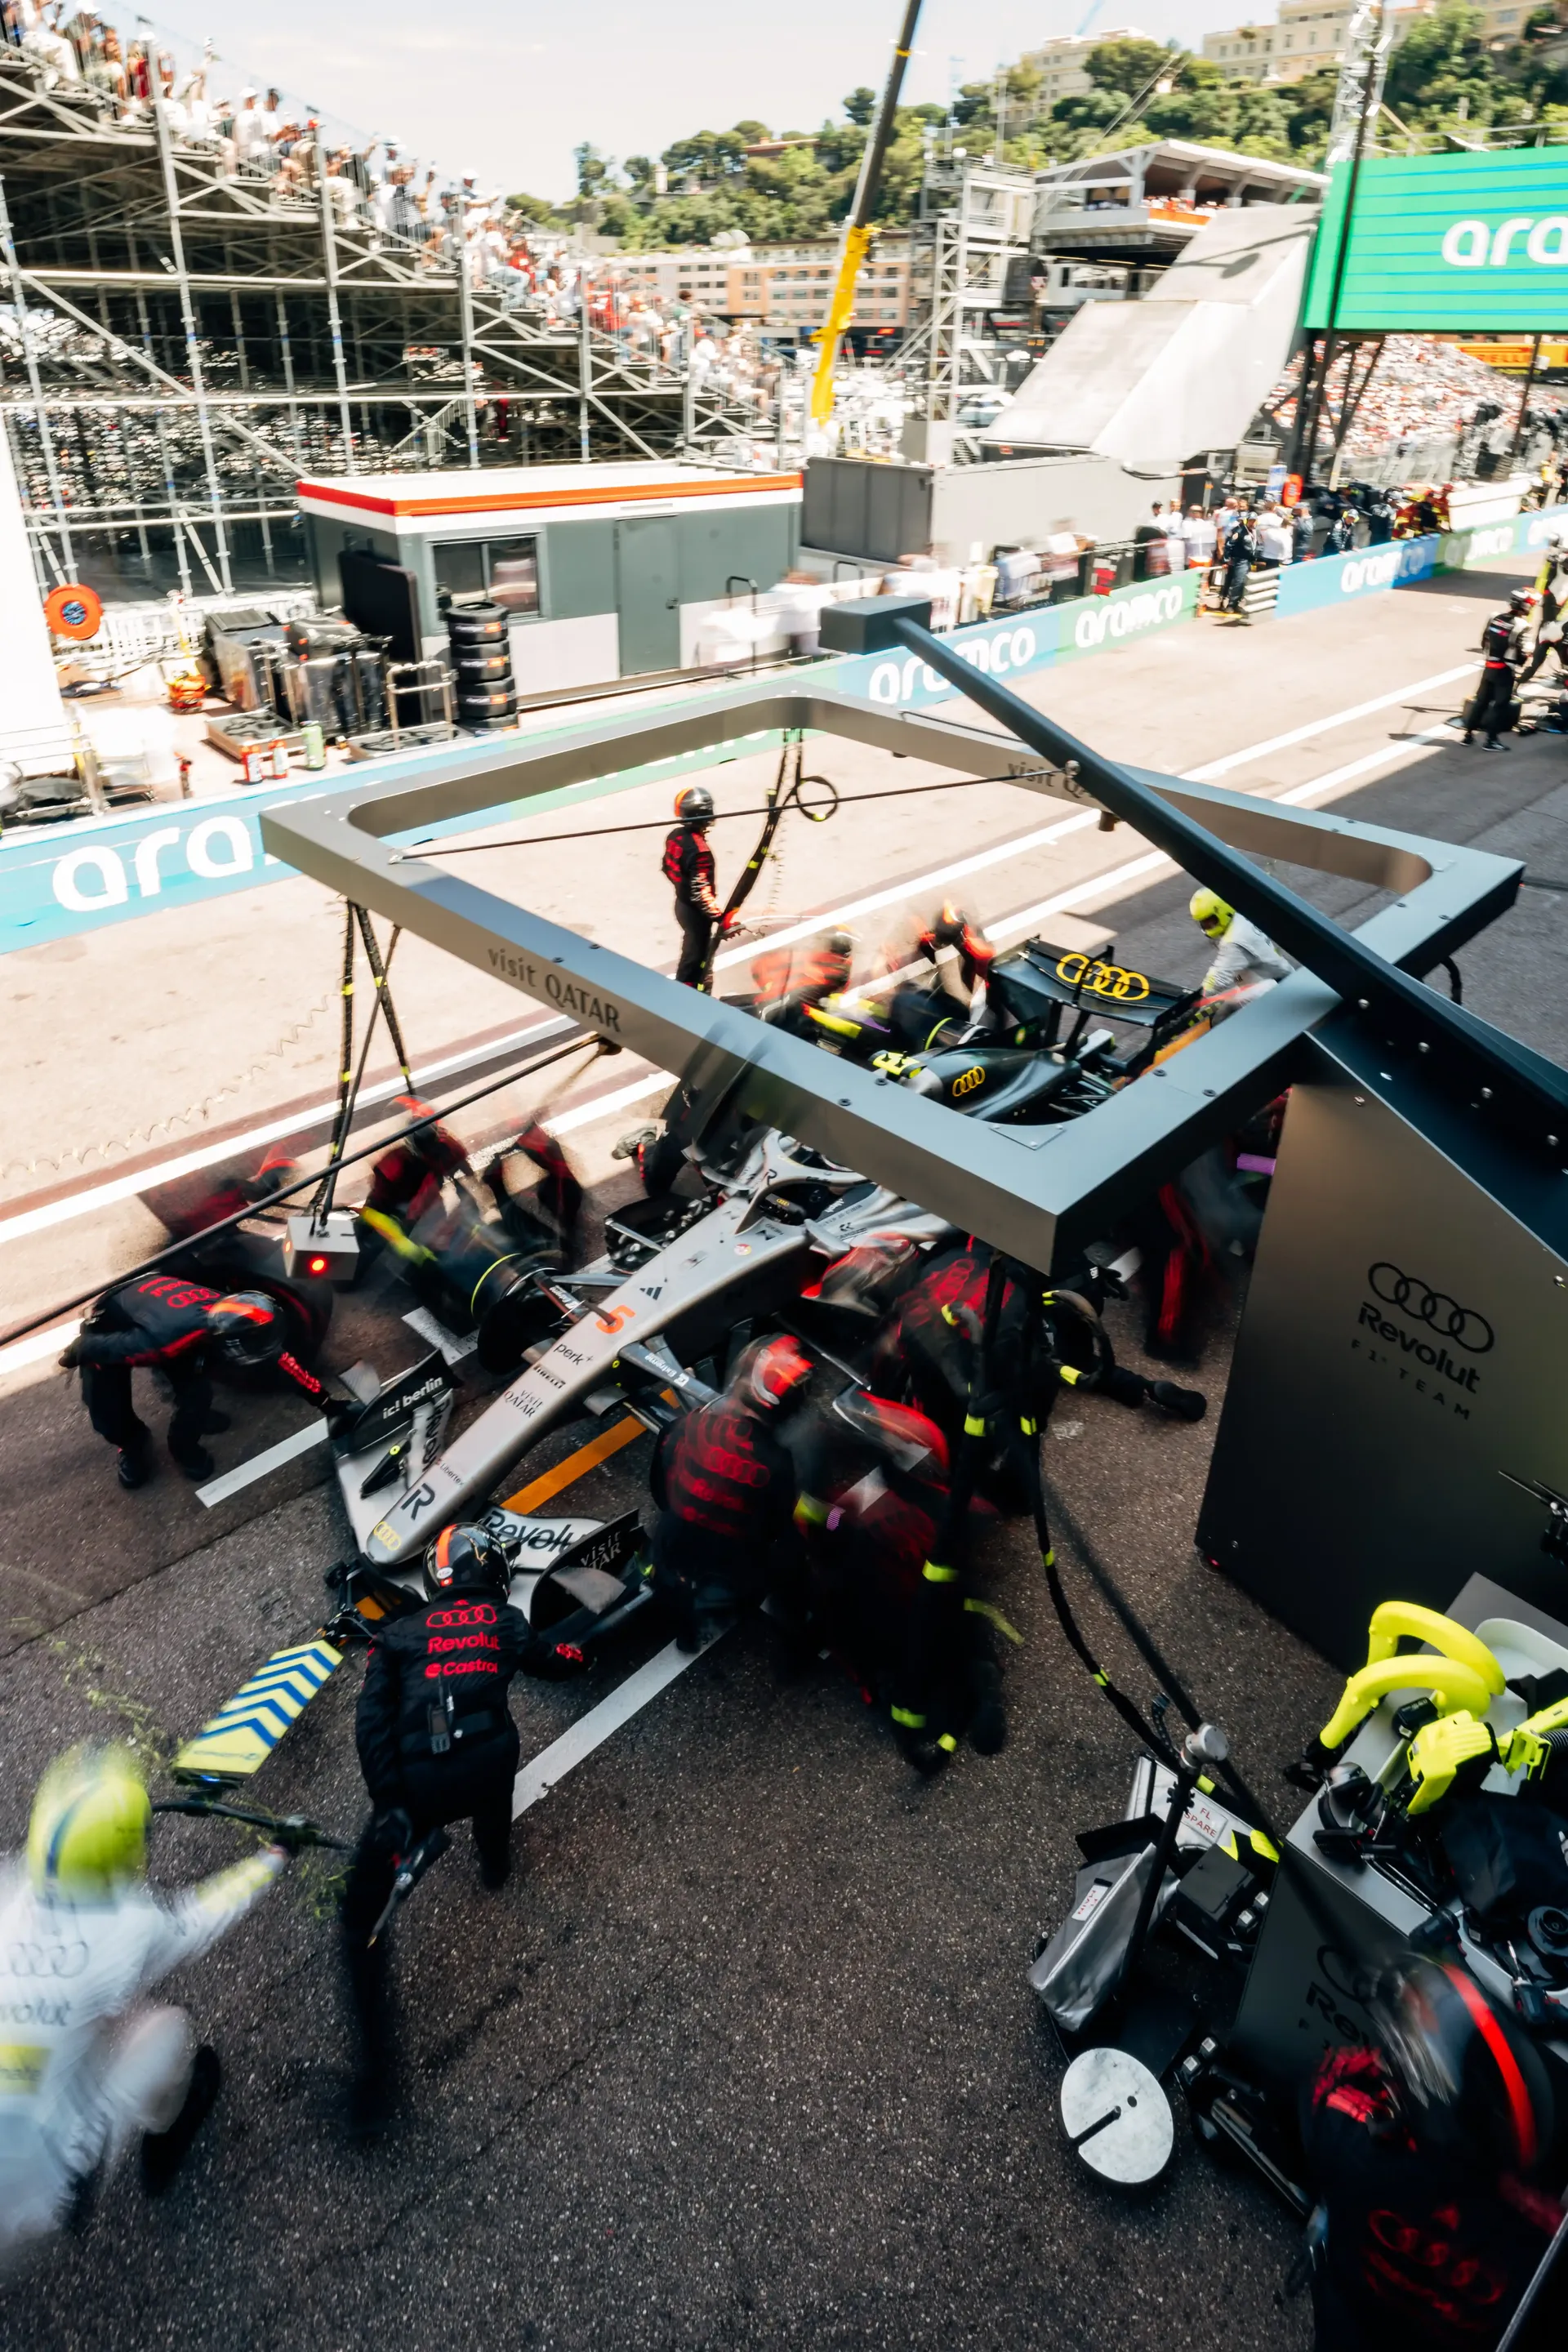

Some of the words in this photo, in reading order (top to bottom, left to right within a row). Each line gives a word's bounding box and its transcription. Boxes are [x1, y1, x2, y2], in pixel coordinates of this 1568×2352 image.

[488, 947, 537, 987] visit
[545, 973, 621, 1032] QATAR
[595, 1304, 636, 1334] 5
[1358, 1301, 1481, 1394] Revolut
[383, 1400, 400, 1419] ic!
[403, 1376, 443, 1407] berlin
[504, 1391, 536, 1418] QATAR
[1399, 1367, 1470, 1420] TEAM
[427, 1632, 501, 1654] Revolut
[1183, 1811, 1217, 1838] SPARE
[1200, 1807, 1211, 1820] FL
